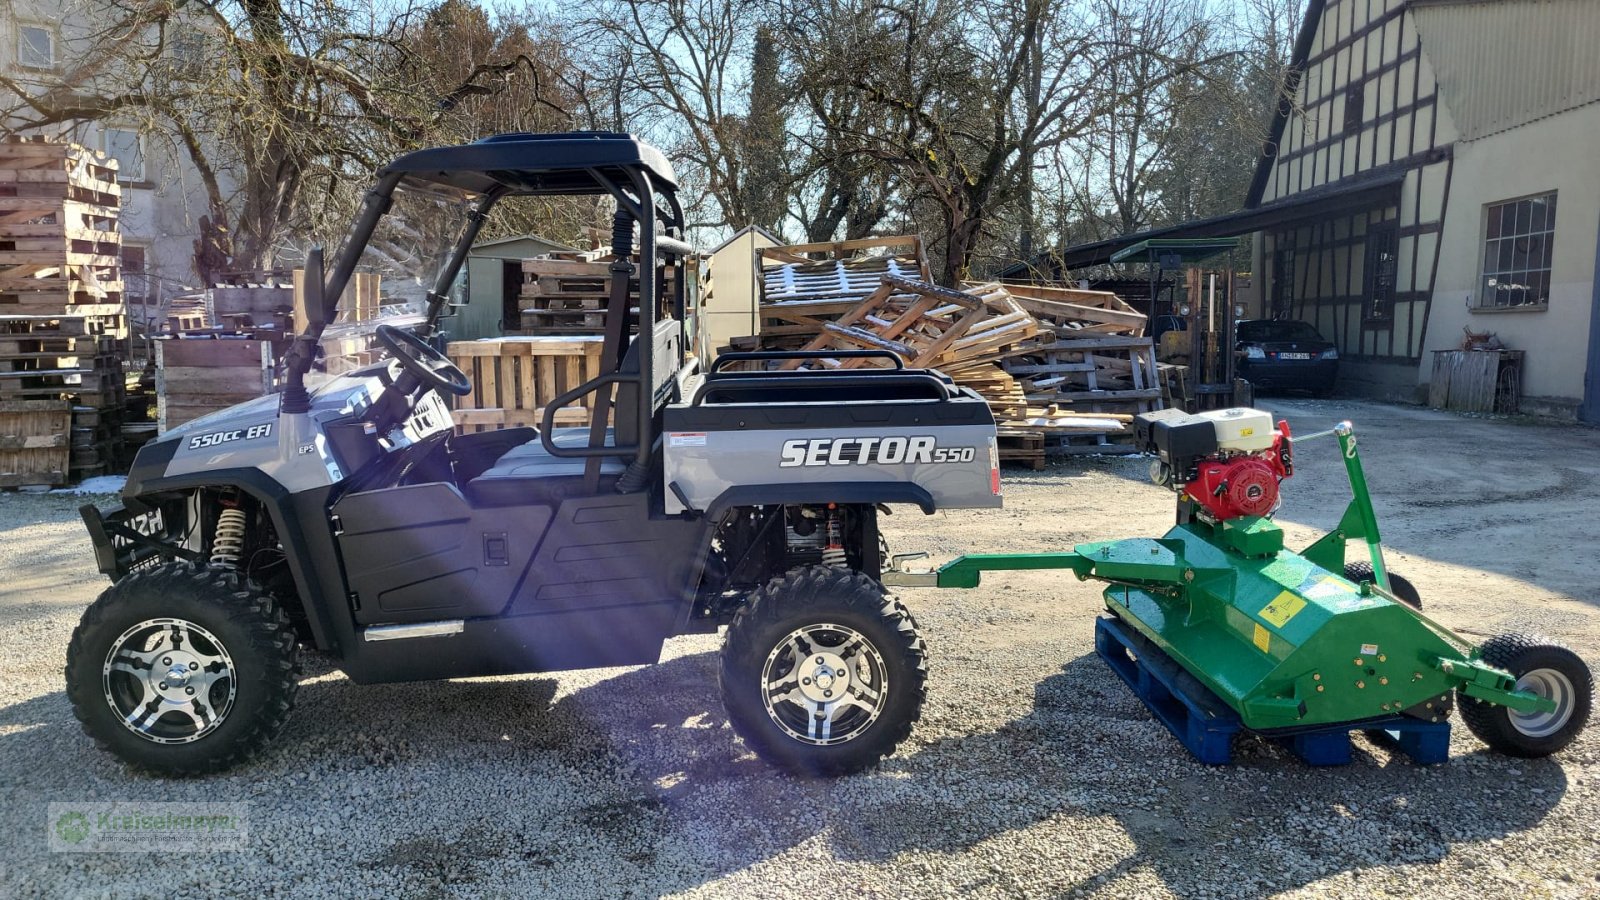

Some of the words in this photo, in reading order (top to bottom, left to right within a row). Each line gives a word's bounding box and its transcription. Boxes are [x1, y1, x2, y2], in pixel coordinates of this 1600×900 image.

[189, 430, 241, 449] 550cc
[246, 424, 272, 439] EFI
[298, 444, 315, 454] EPS
[780, 436, 936, 467] SECTOR
[933, 448, 975, 463] 550
